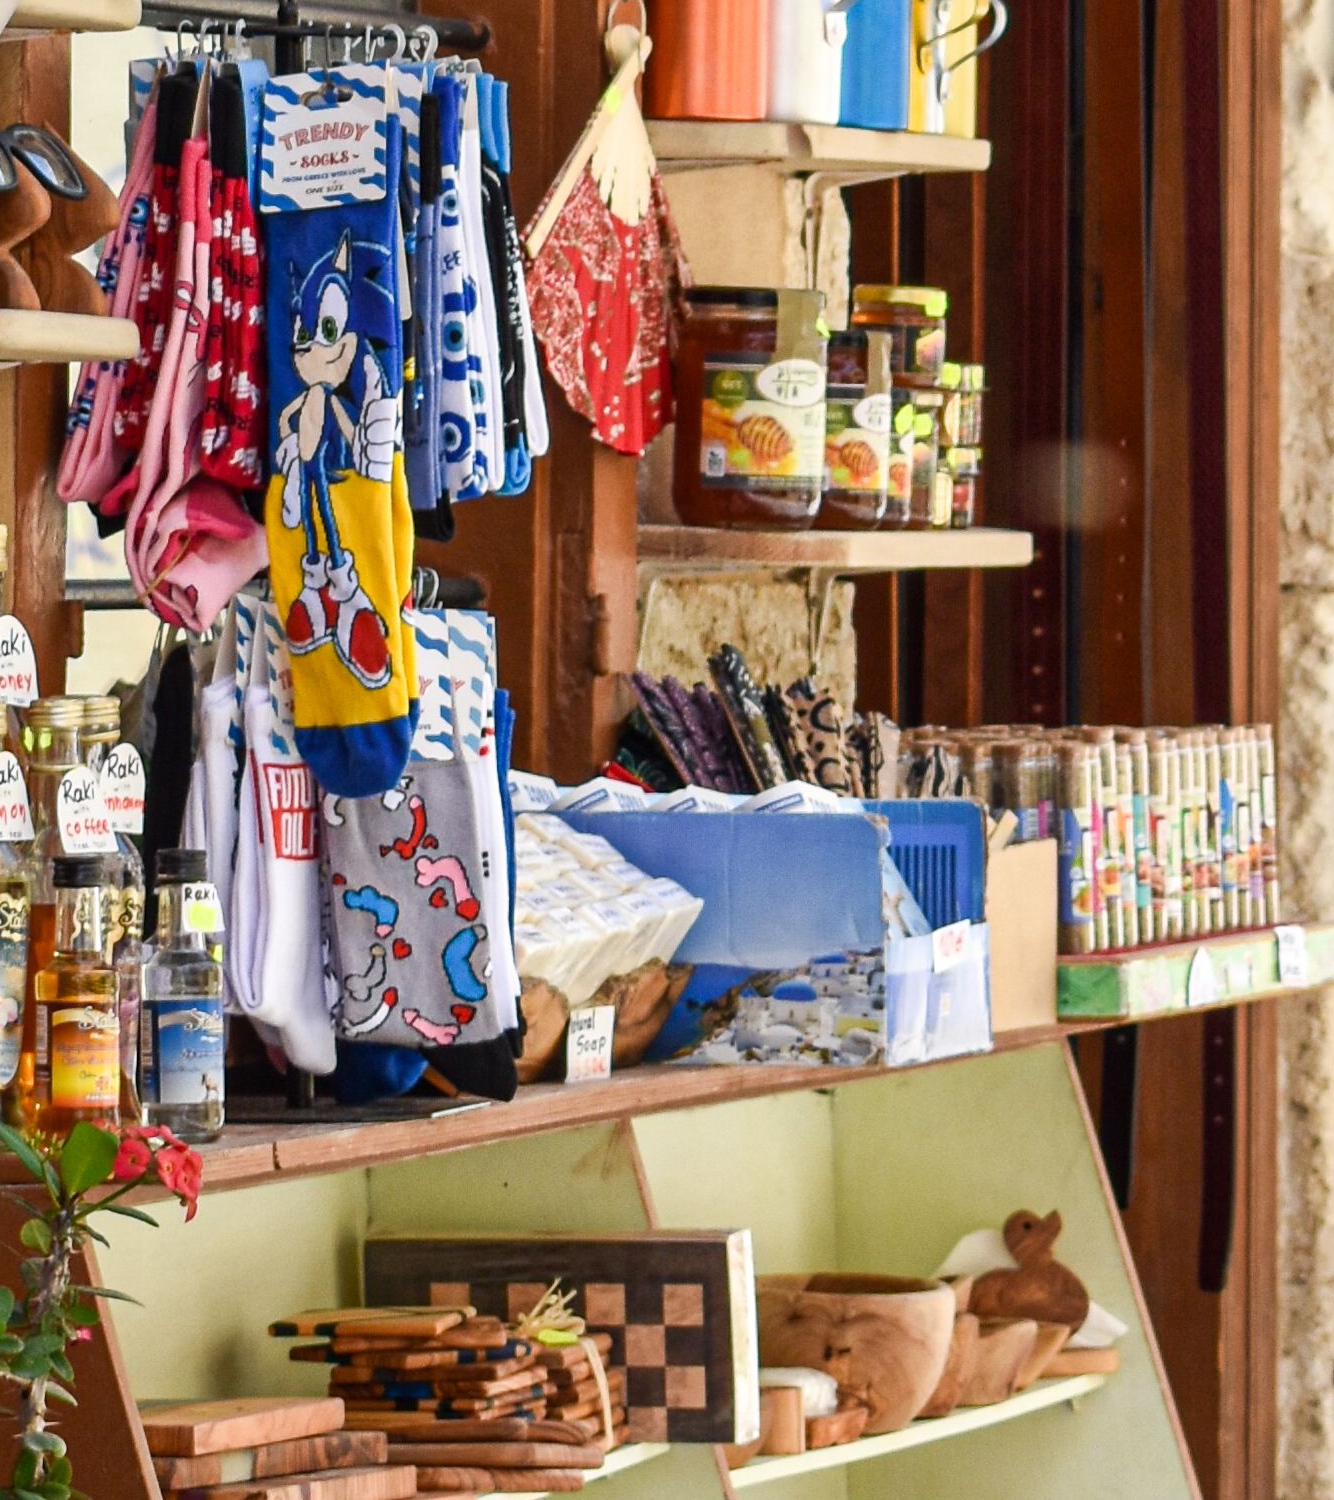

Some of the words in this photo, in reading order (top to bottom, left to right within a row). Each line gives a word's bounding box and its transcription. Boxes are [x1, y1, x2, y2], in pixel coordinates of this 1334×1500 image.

[278, 121, 370, 151] TRENDY
[300, 150, 349, 168] SOCKS
[306, 186, 324, 194] ONE
[327, 184, 343, 192] SIZE
[107, 753, 139, 778] Raki
[62, 779, 94, 803] Raki
[66, 818, 110, 837] coffee
[184, 886, 215, 901] Raki
